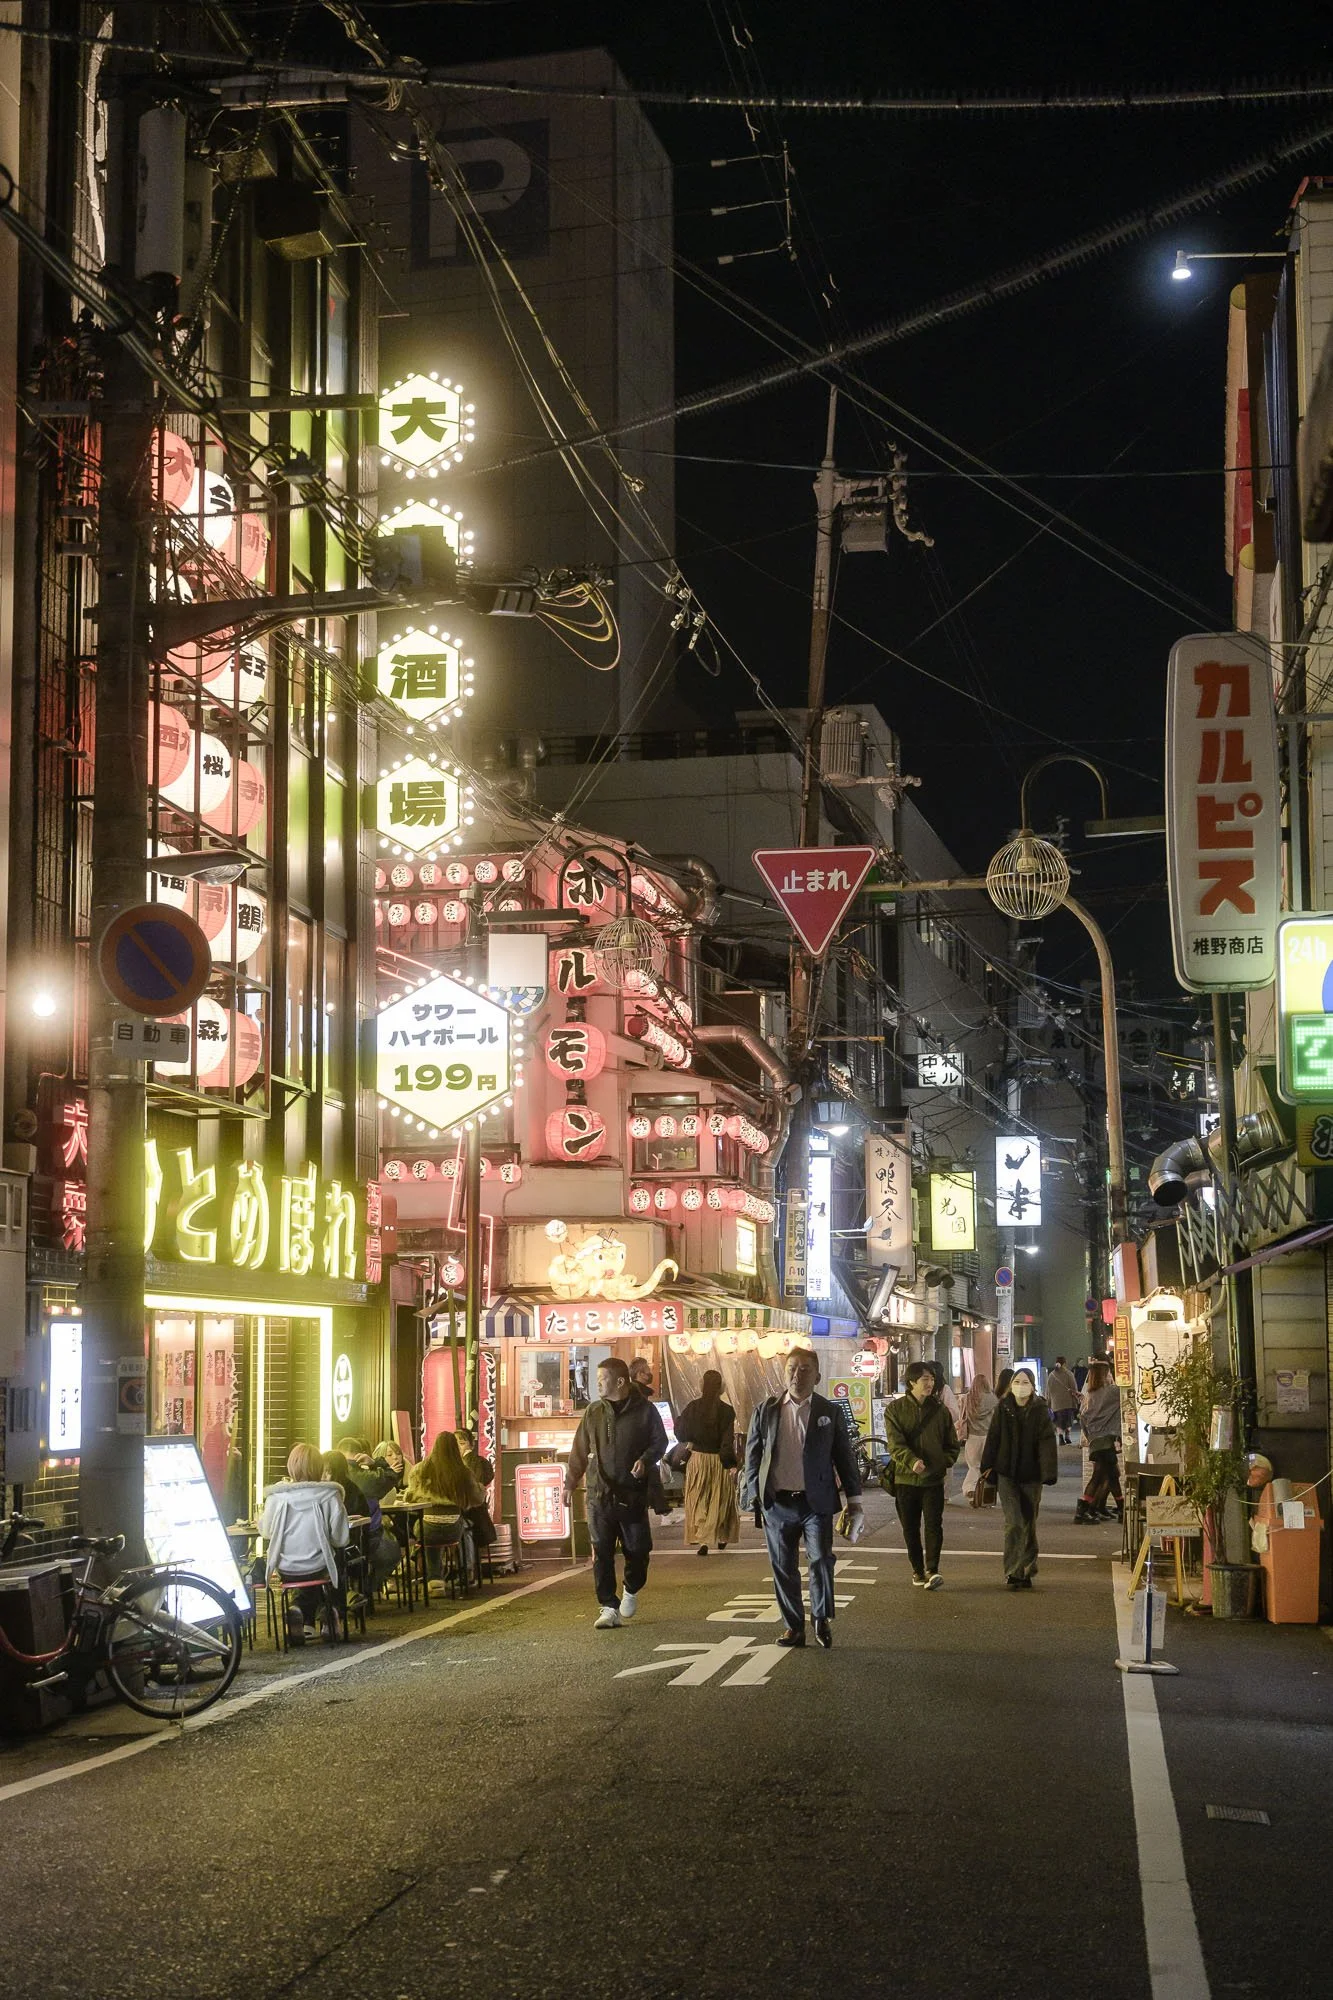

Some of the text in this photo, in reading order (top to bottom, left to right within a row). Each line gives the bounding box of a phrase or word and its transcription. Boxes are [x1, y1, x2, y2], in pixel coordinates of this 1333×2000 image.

[1194, 660, 1263, 916] カルピス
[781, 868, 851, 893] 止まれ
[1193, 935, 1264, 956] 椎野商店
[412, 1004, 477, 1021] サワー
[118, 1023, 186, 1044] 自動車
[388, 1026, 499, 1047] ハイボール
[922, 1055, 957, 1068] 中村
[923, 1072, 958, 1085] ビル
[545, 1307, 677, 1333] たこ焼き
